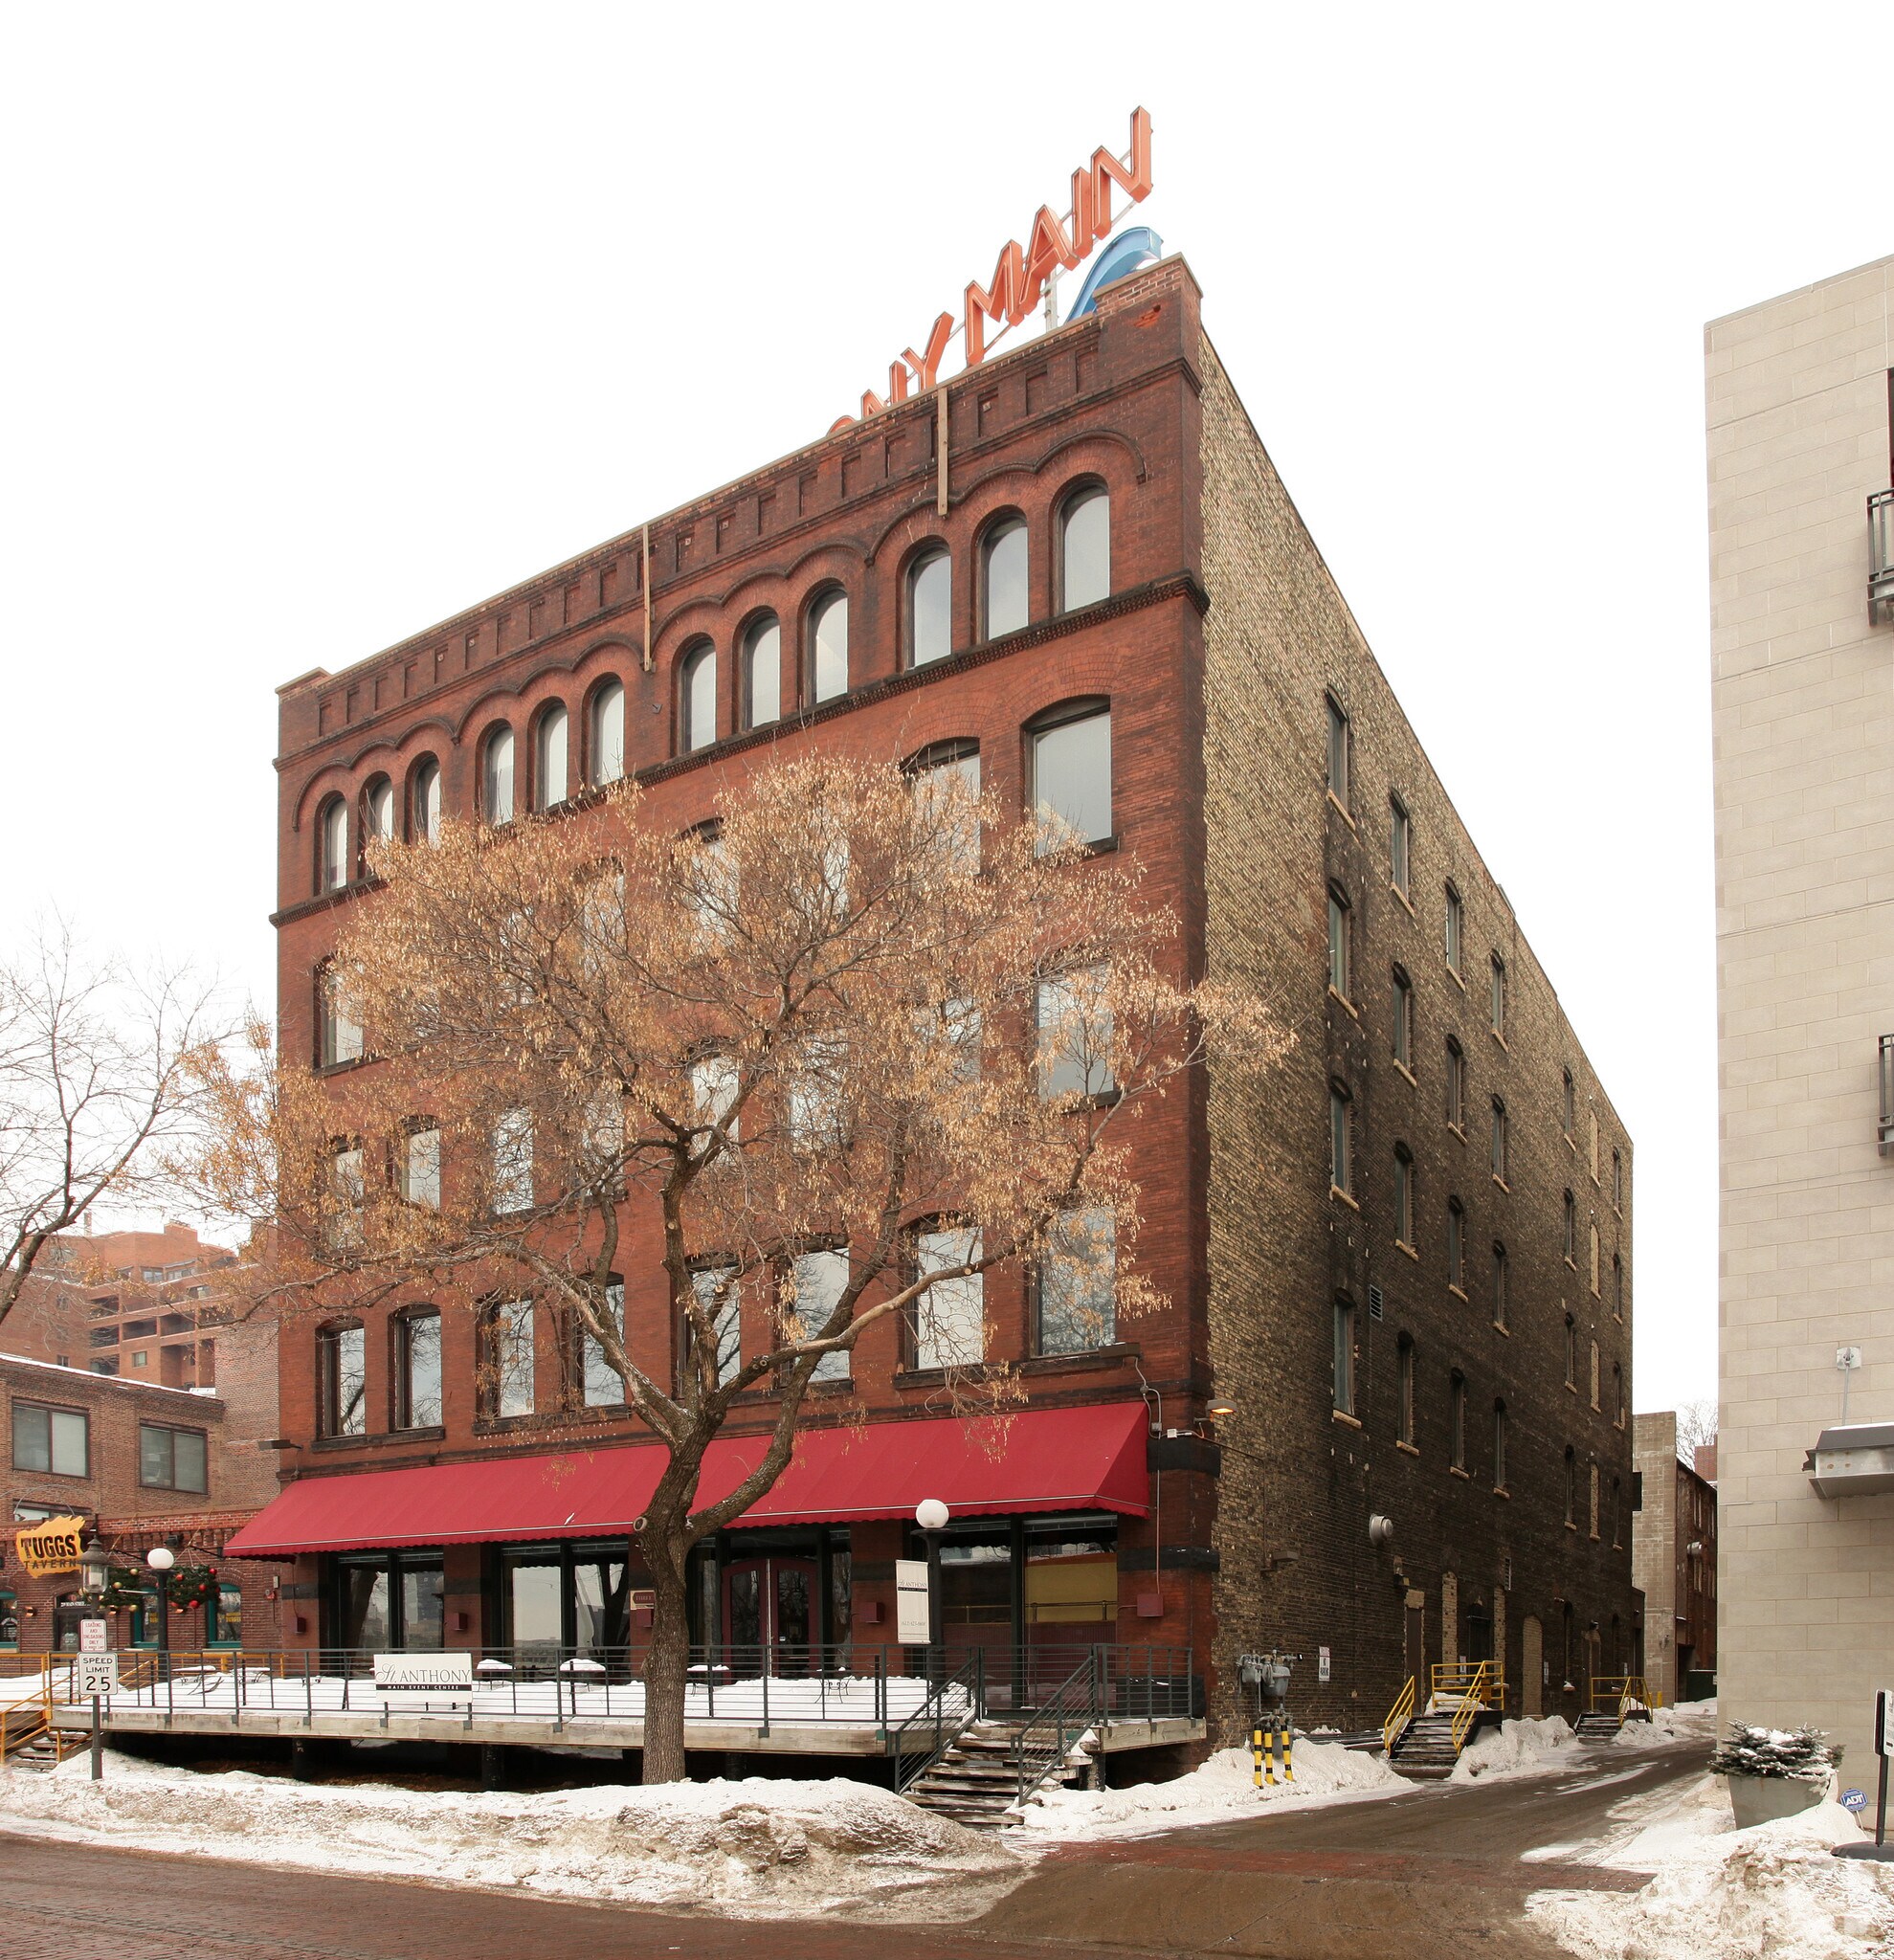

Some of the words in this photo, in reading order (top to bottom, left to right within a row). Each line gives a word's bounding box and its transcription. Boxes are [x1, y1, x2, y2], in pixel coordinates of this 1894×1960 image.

[965, 105, 1152, 368] MAIN
[21, 1534, 77, 1559] TUGGS
[24, 1559, 78, 1570] TAVERN
[400, 1669, 471, 1682] ANTHONY
[85, 1676, 111, 1691] 25
[1846, 1793, 1863, 1806] ADT
